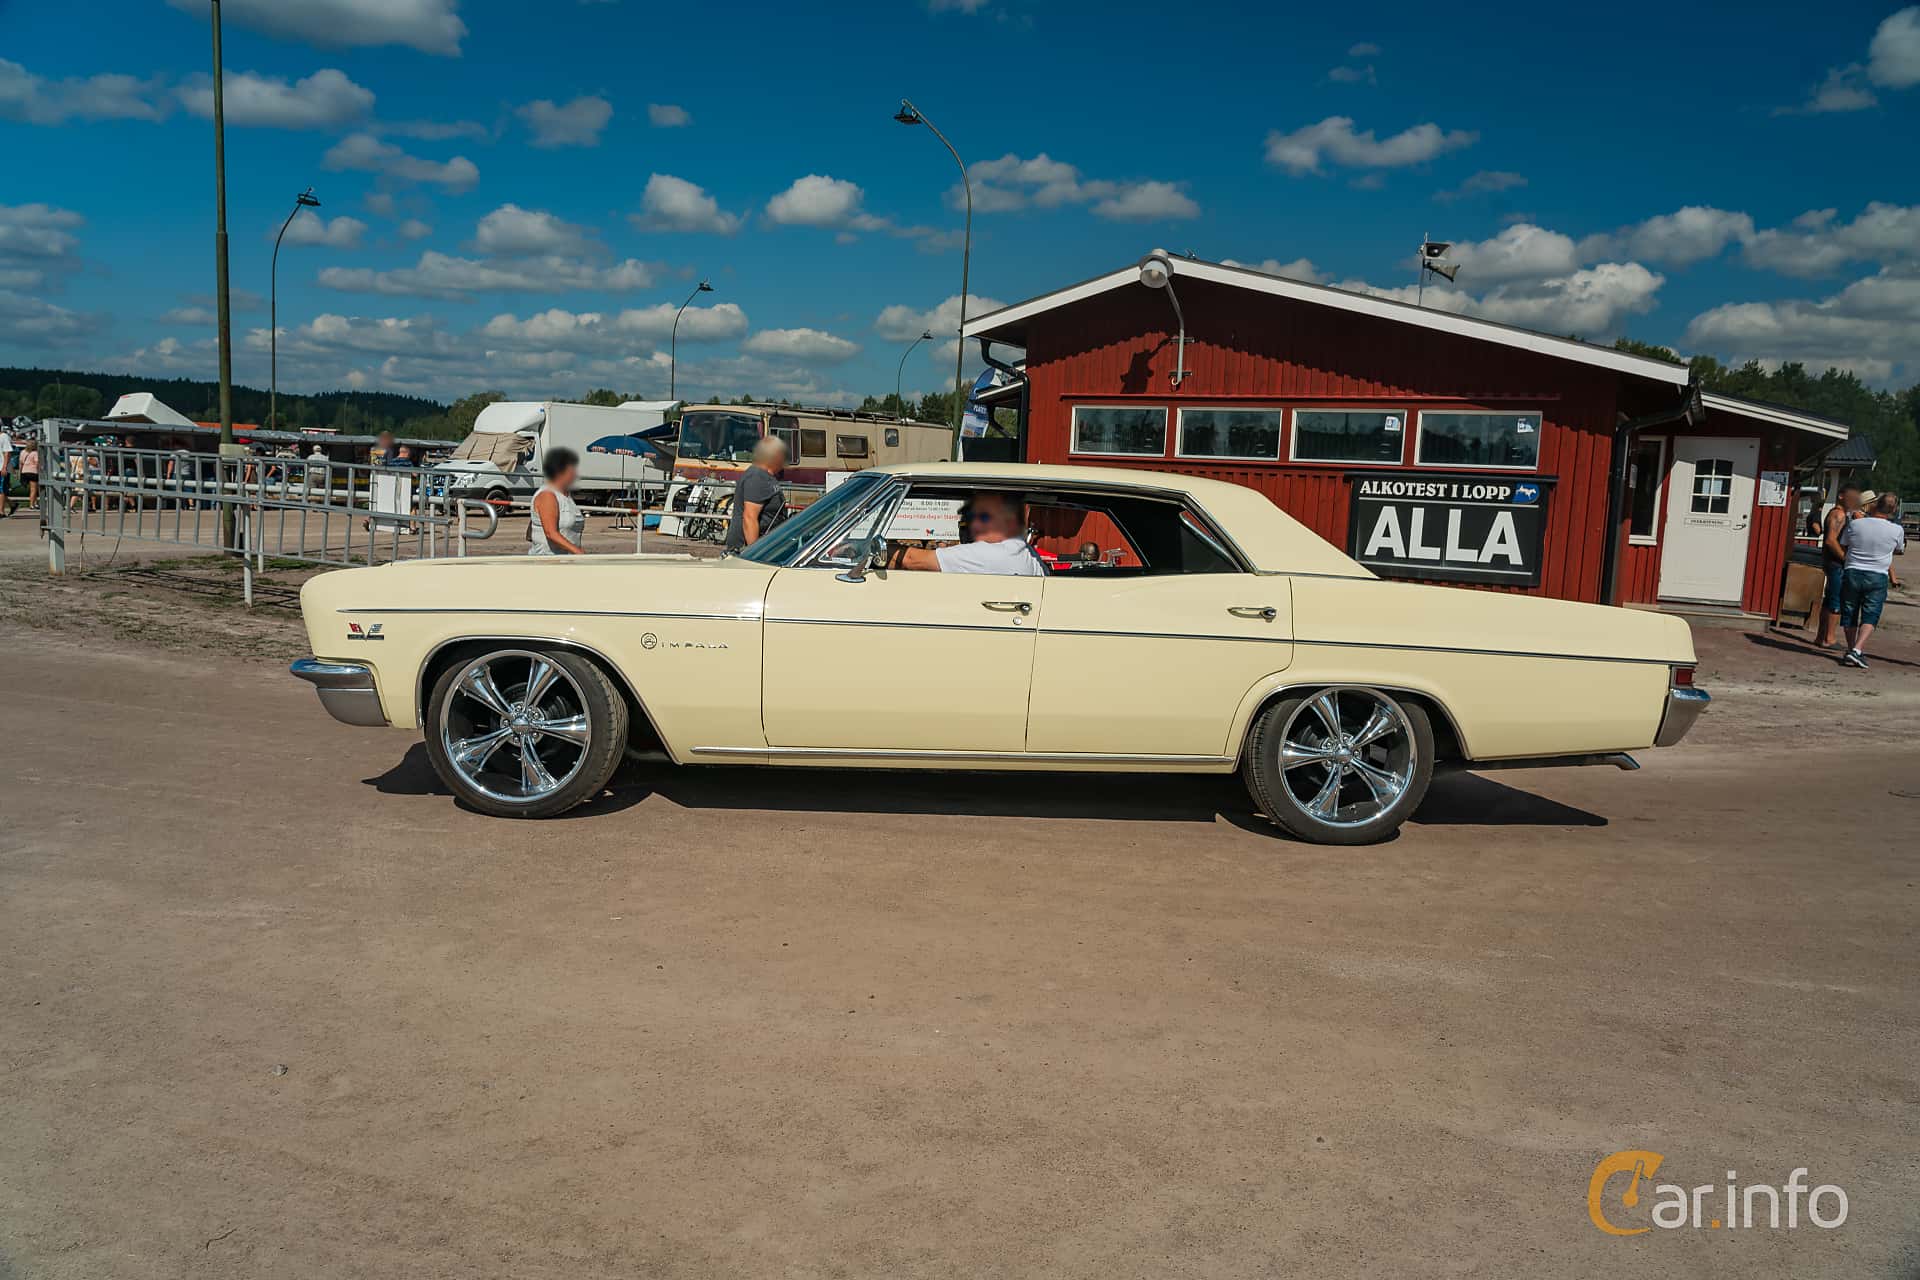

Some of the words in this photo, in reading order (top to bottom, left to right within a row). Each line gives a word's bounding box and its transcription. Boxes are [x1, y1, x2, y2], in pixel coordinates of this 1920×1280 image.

[1359, 481, 1447, 497] ALKOTEST
[1450, 484, 1459, 498] I
[1462, 484, 1511, 500] LOPP
[1364, 505, 1523, 565] ALLA
